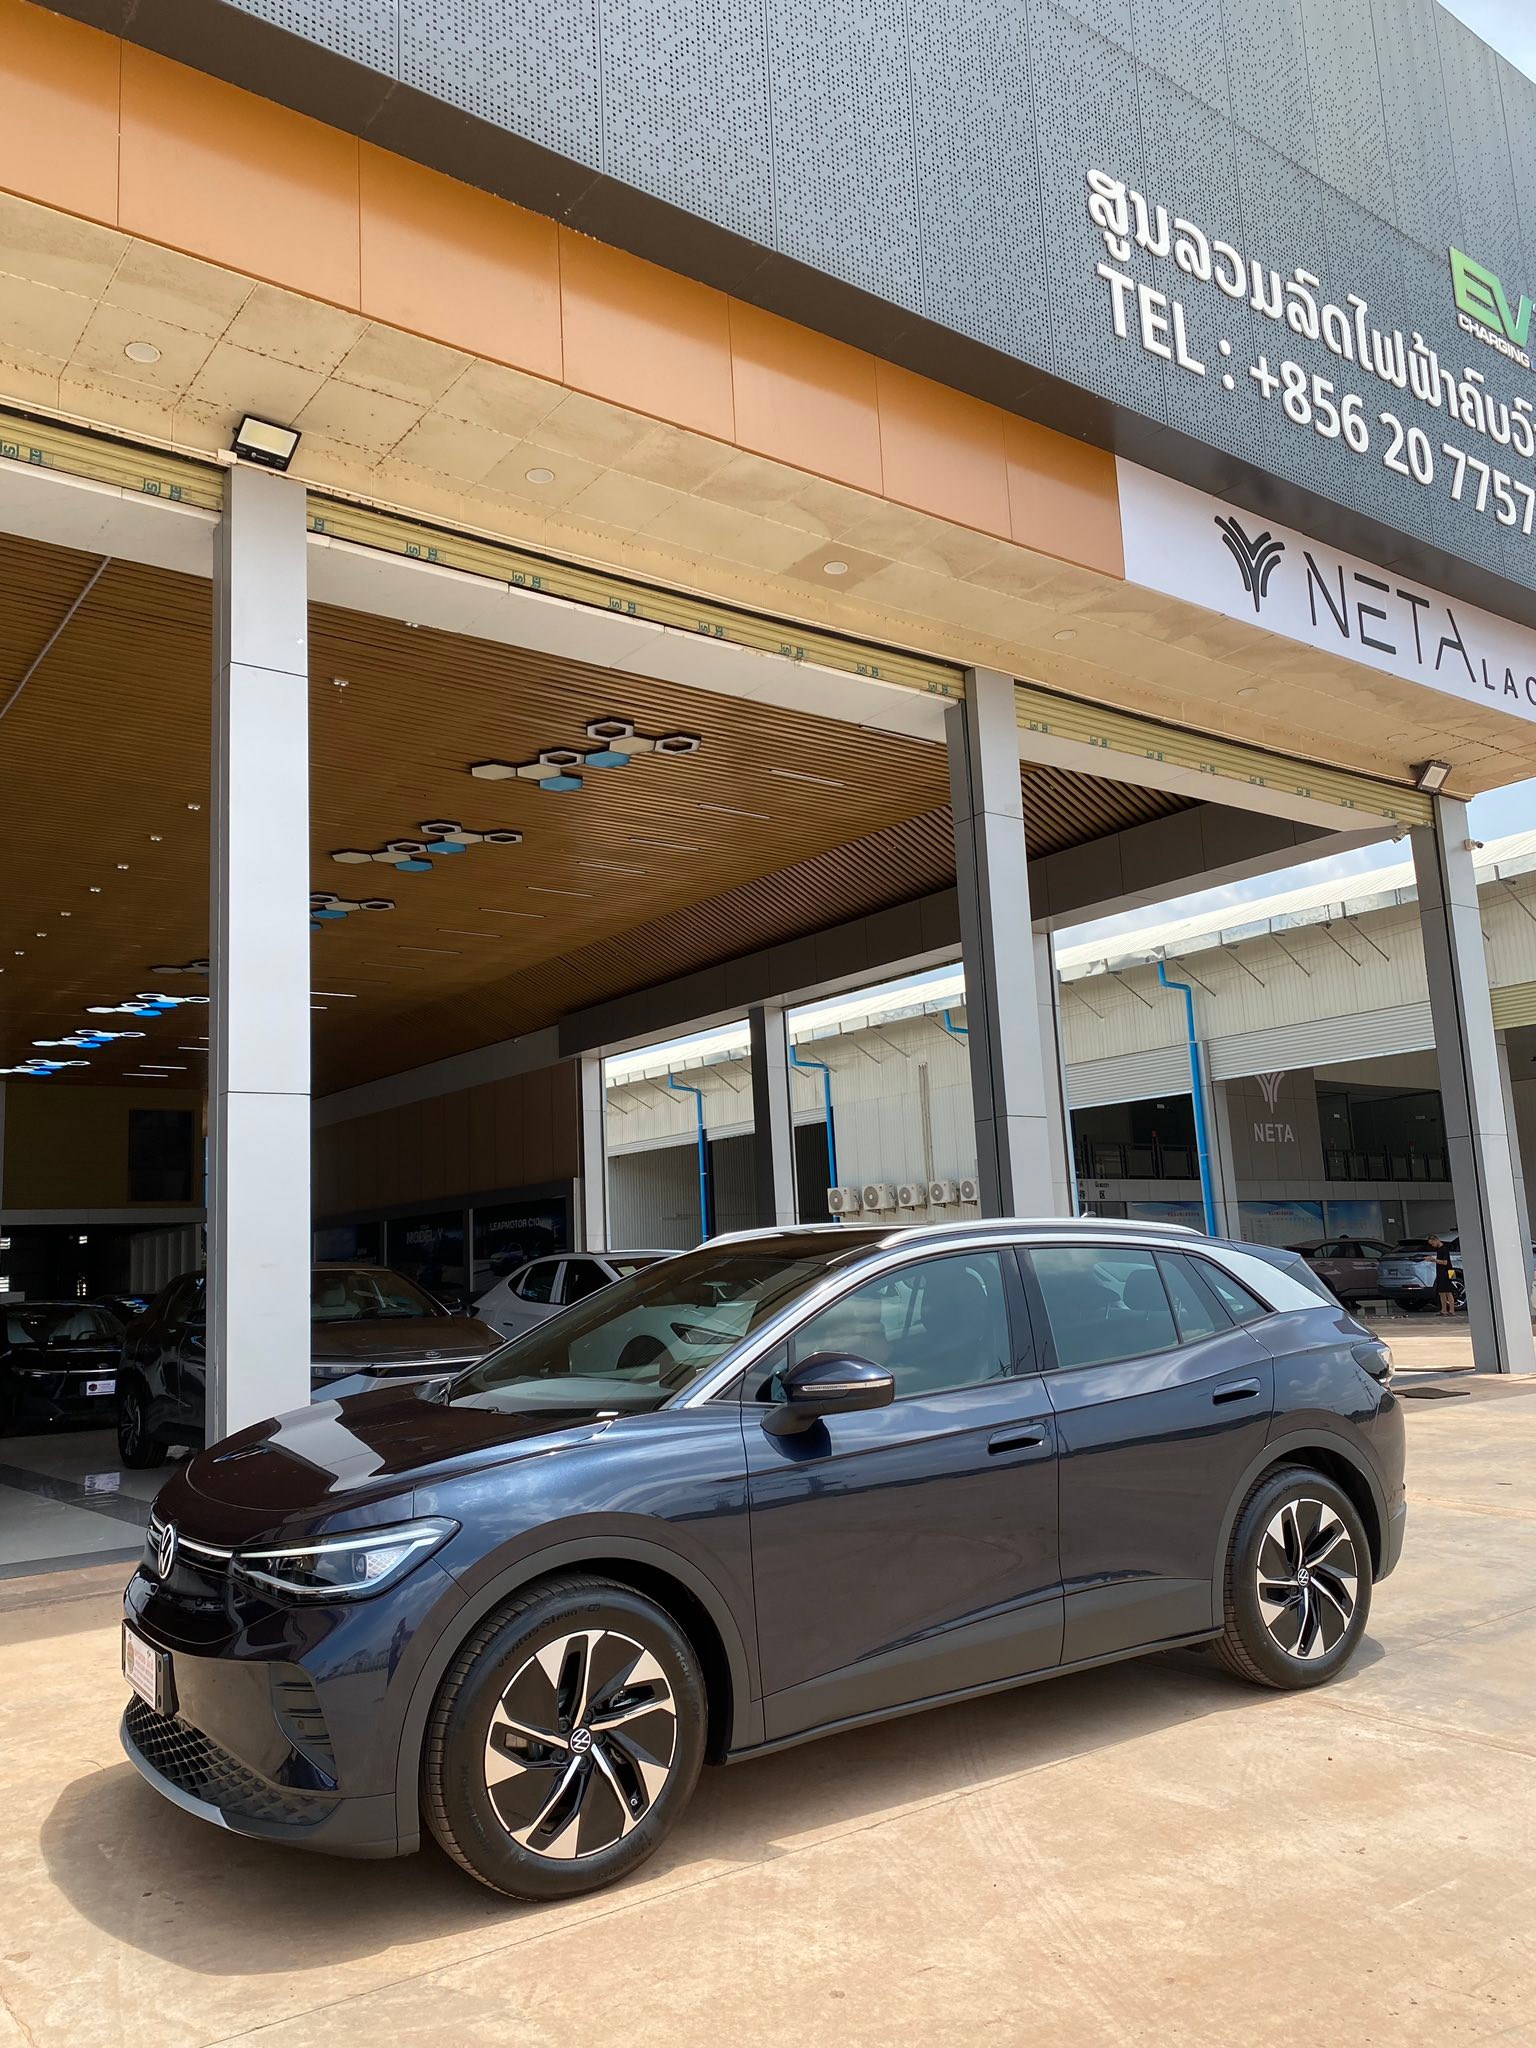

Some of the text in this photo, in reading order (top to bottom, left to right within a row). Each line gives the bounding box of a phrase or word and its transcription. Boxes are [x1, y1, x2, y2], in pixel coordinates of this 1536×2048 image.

[1458, 312, 1530, 369] CHARGING
[1097, 262, 1205, 376] TEL
[1250, 355, 1369, 453] +856
[1379, 412, 1434, 485] 20
[1441, 442, 1535, 535] 7757
[1303, 551, 1477, 683] NETA
[1253, 1122, 1295, 1143] NETA
[489, 1219, 527, 1231] LEAPMOTOR
